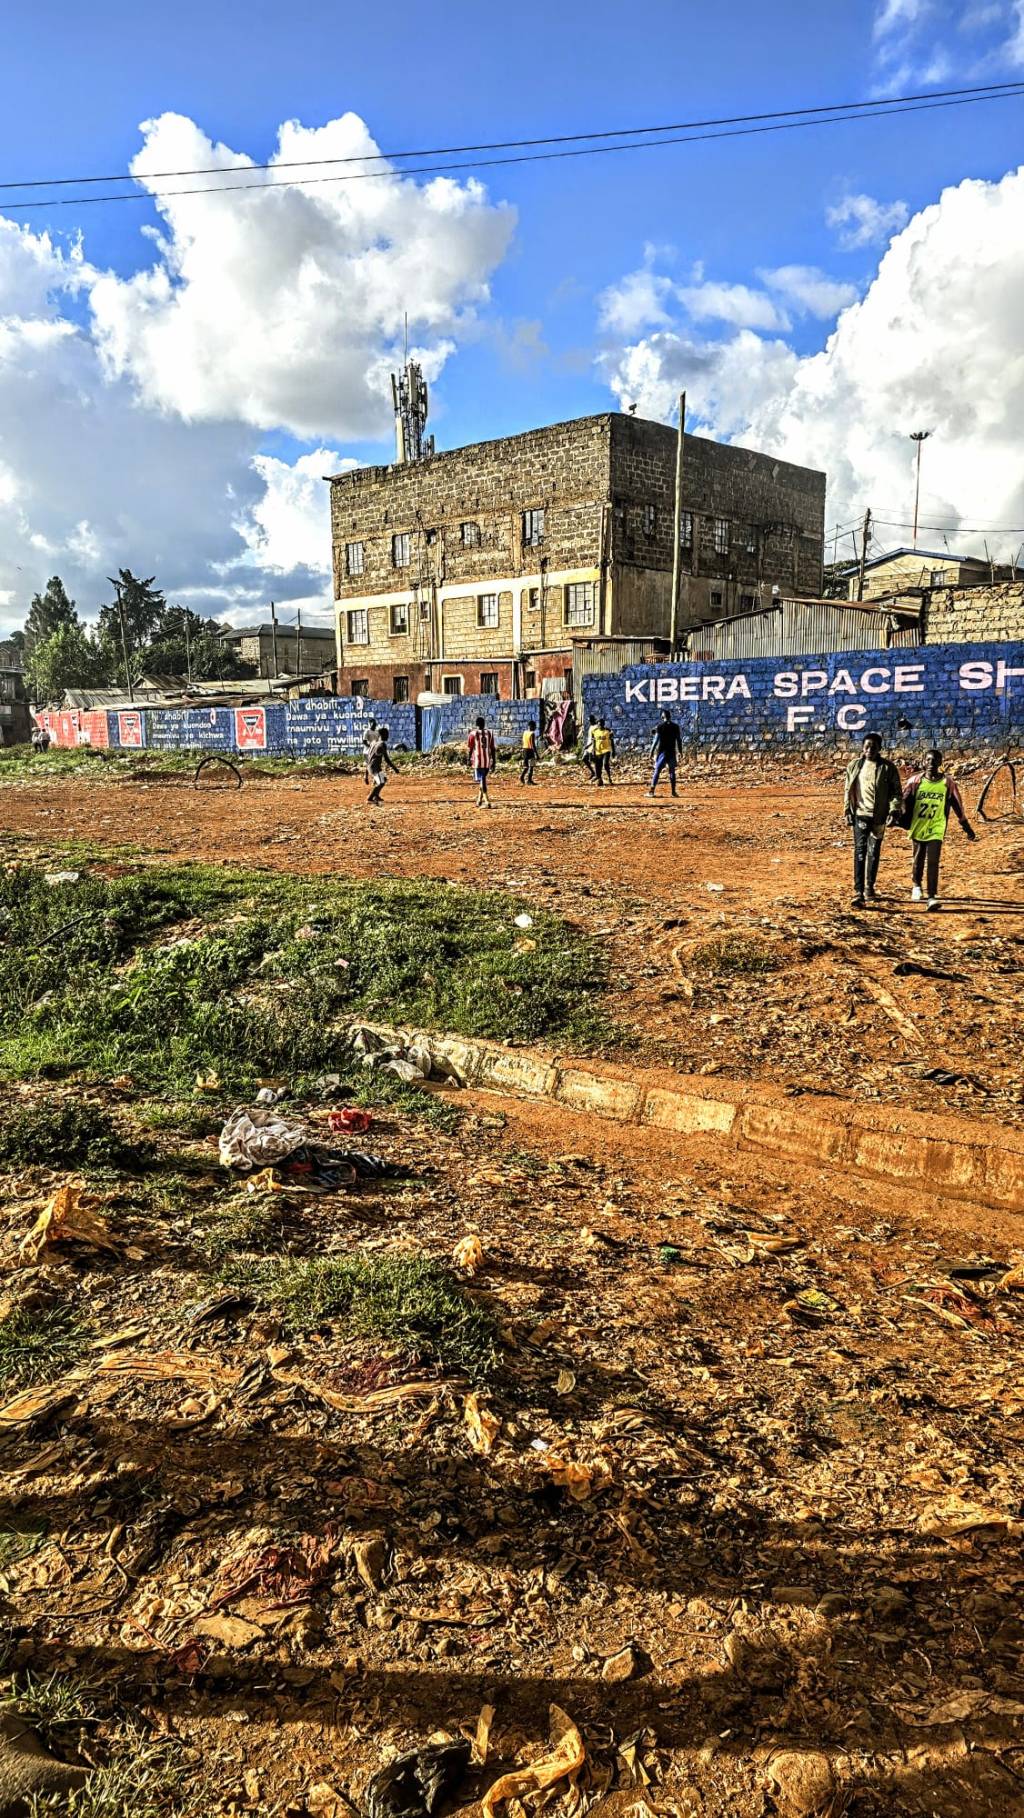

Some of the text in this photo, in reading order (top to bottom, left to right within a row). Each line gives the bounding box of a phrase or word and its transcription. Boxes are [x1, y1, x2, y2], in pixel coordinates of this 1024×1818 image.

[625, 673, 752, 703] KIBERA
[773, 664, 925, 698] SPACE
[289, 700, 300, 713] Ni
[286, 713, 308, 721] Dawa
[315, 713, 327, 722] ya
[287, 723, 329, 732] maumivu
[336, 725, 347, 734] ya
[303, 735, 322, 747] joto
